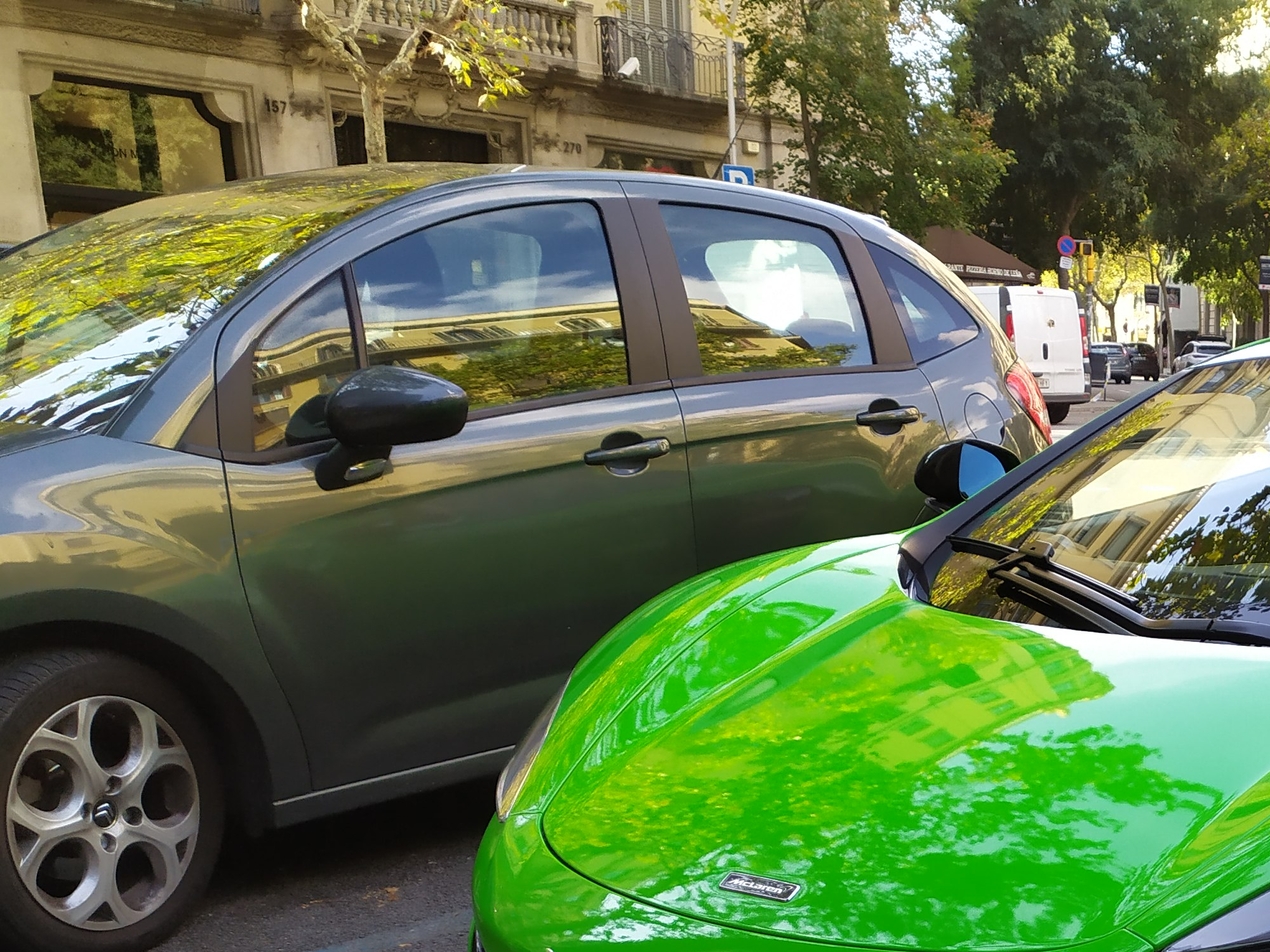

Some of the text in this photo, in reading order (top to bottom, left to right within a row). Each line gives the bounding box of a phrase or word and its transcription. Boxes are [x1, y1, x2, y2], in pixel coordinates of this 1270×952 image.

[265, 98, 286, 114] 157
[563, 141, 582, 154] 270
[729, 877, 783, 895] McLaren
